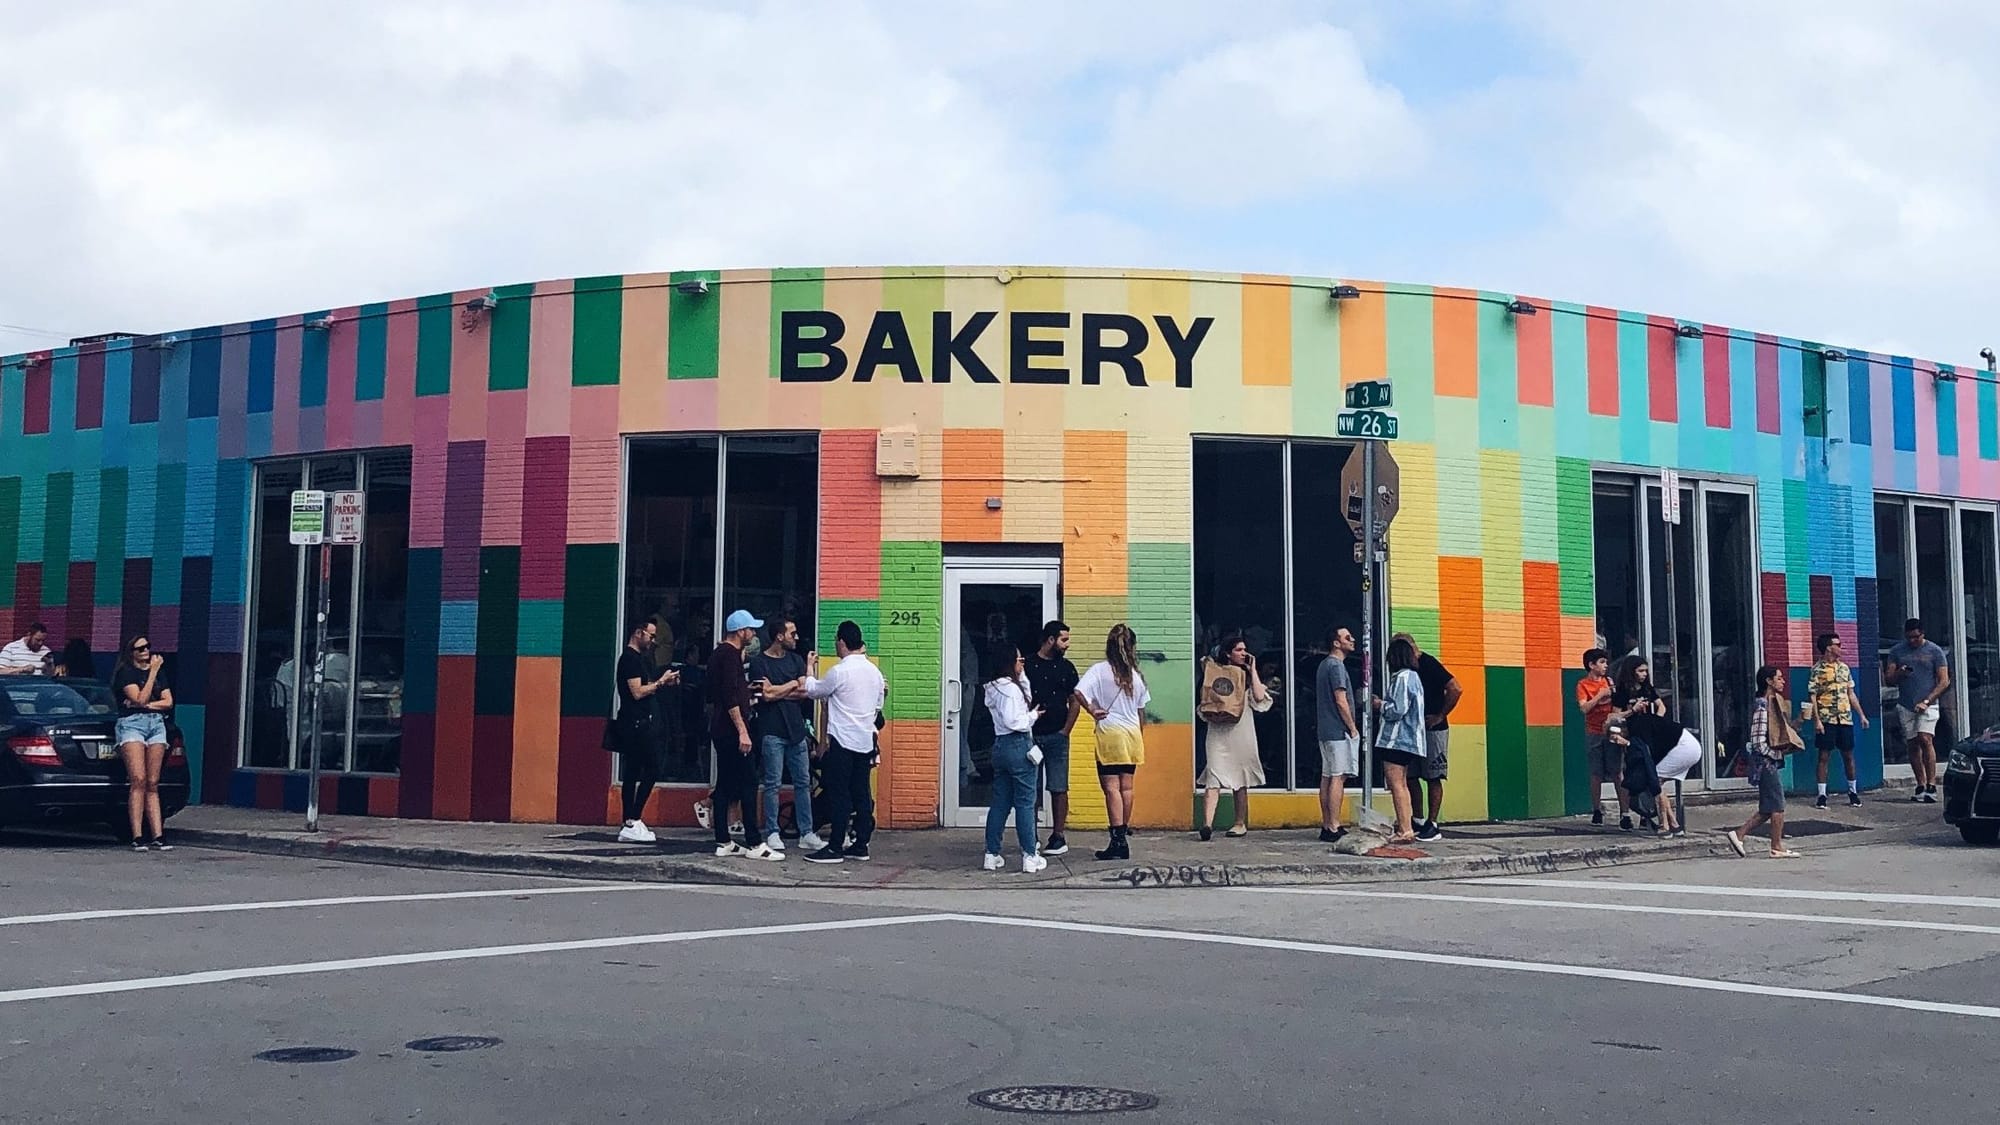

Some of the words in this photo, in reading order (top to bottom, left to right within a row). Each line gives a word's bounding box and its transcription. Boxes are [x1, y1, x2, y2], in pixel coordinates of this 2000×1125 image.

[780, 311, 1216, 389] BAKERY
[1361, 386, 1369, 405] 3
[1379, 386, 1389, 401] AV
[1339, 417, 1354, 431] NW
[1361, 414, 1381, 436] 26
[1387, 419, 1396, 434] ST
[342, 494, 355, 505] NO
[335, 505, 361, 515] PARKING
[890, 611, 921, 626] 295
